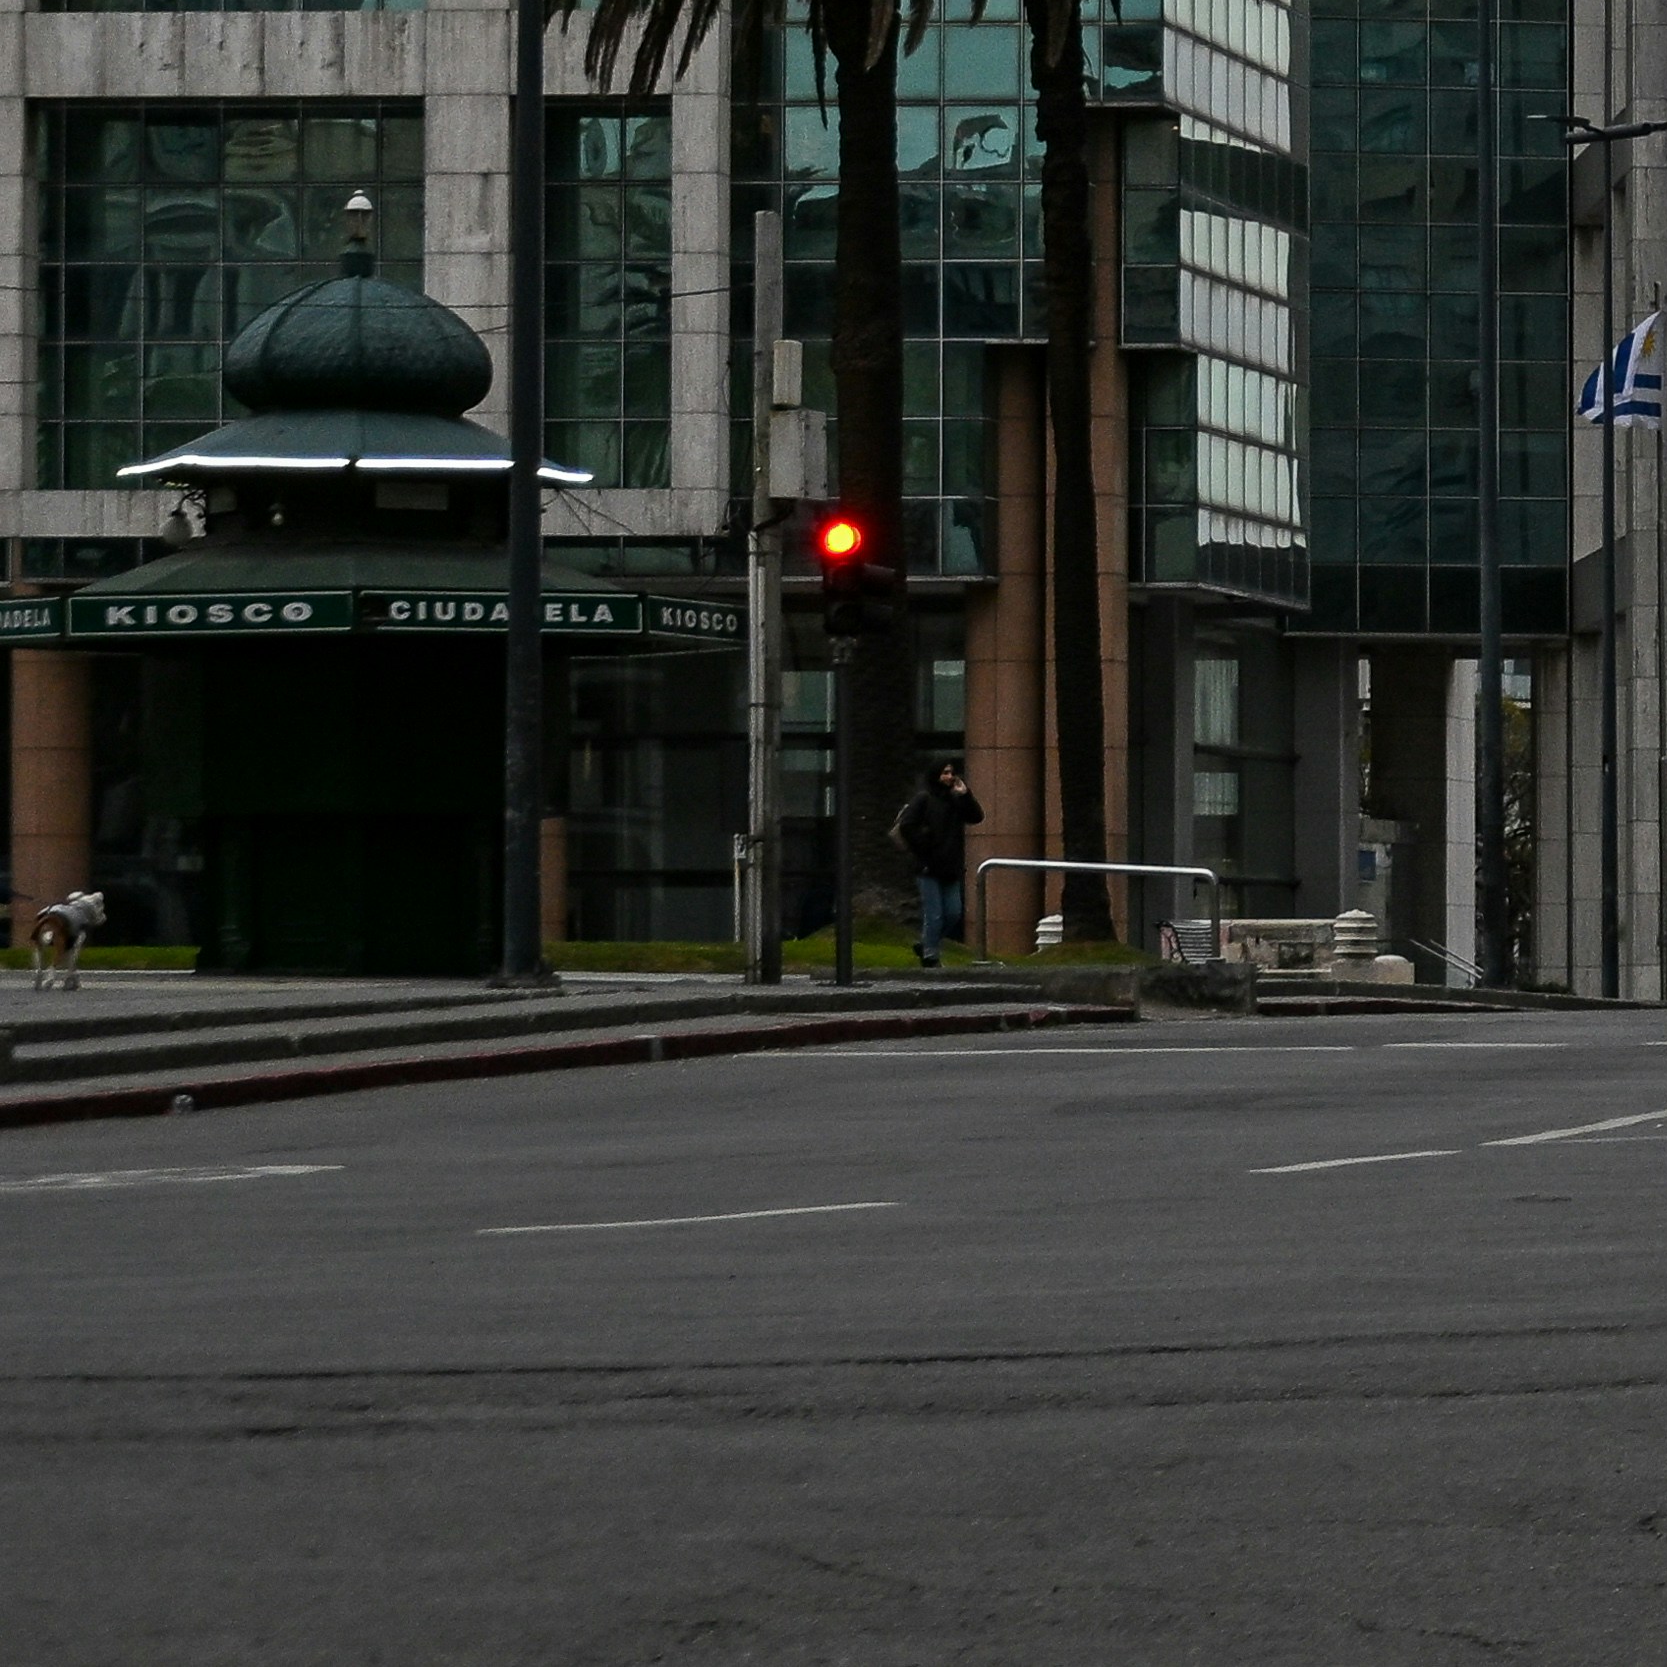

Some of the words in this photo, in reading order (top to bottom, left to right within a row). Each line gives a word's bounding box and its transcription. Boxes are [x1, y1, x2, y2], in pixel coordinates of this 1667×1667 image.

[0, 608, 51, 628] ADELA
[106, 601, 313, 625] KIOSCO
[390, 601, 614, 623] CIUDAELA
[661, 606, 738, 632] KIOSCO
